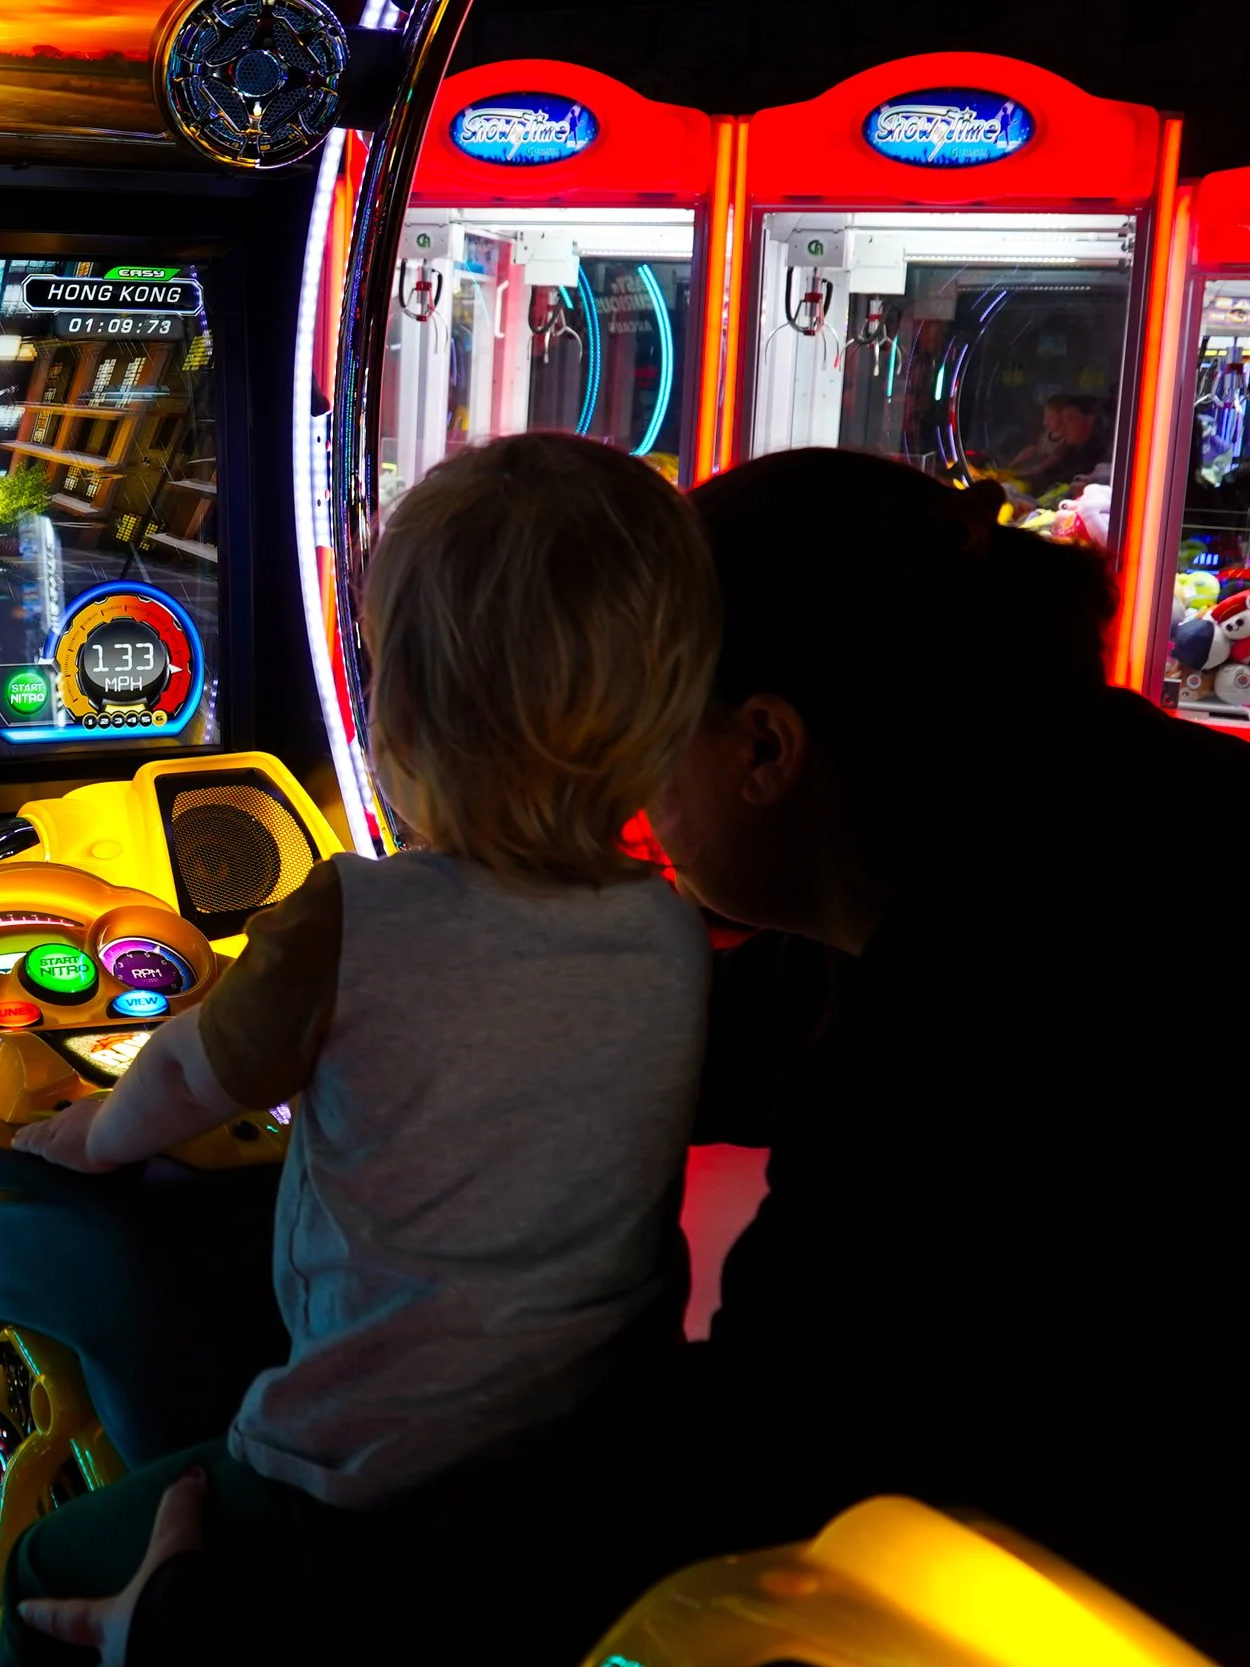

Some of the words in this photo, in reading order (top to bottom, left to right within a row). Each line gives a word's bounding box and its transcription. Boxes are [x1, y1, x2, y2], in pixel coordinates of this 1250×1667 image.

[118, 269, 165, 278] EASY
[48, 284, 113, 301] HONG
[119, 286, 182, 303] KONG
[69, 317, 172, 335] 01:09:73
[92, 643, 154, 672] 133
[11, 682, 43, 693] START
[105, 676, 143, 693] MPH
[10, 693, 45, 704] NITRO
[40, 955, 79, 968] START
[40, 962, 90, 978] NITRO
[131, 968, 163, 980] RPM
[125, 996, 159, 1007] VIEW
